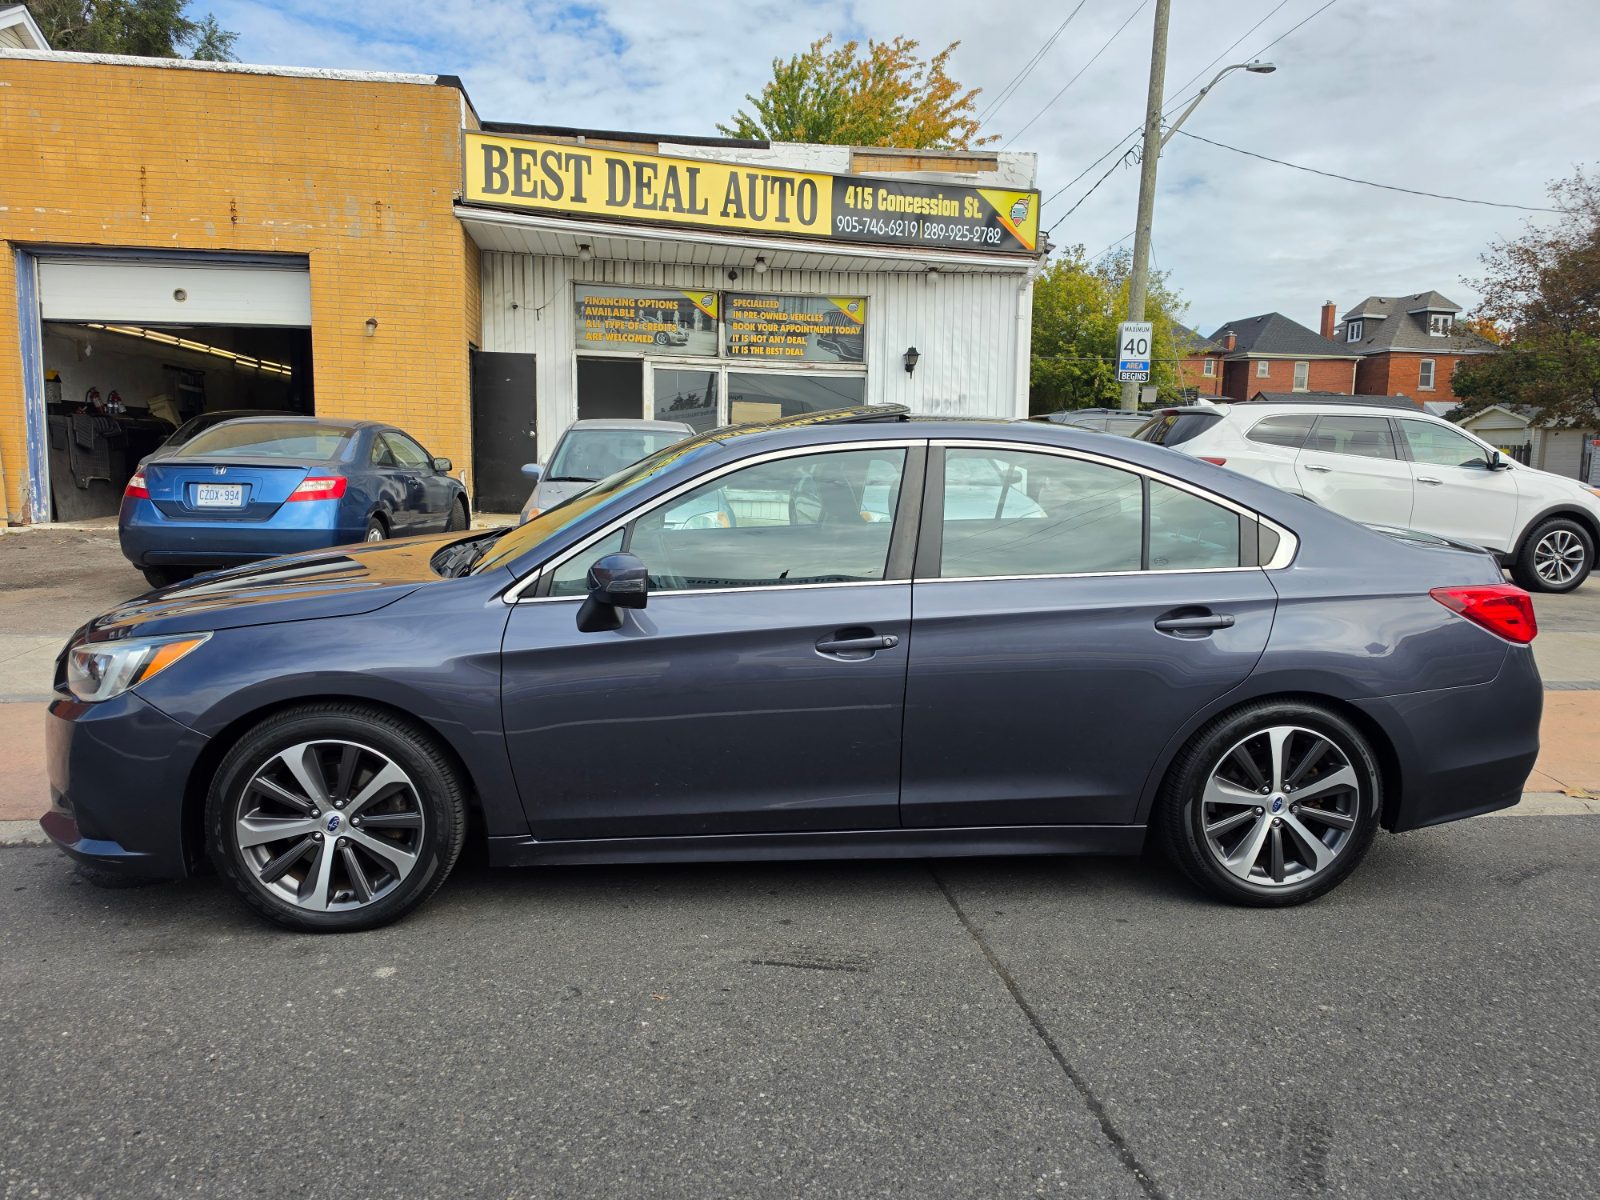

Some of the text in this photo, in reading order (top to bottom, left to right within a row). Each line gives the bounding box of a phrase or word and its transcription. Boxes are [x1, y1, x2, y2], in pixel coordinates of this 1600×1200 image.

[481, 143, 818, 226] BEST DEAL AUTO
[844, 185, 982, 219] 415 Concession St.
[836, 215, 1001, 244] 905-746-6219 289-925-2782
[584, 296, 679, 310] FINANCING OPTIONS
[733, 298, 780, 309] SPECIALIZED
[585, 306, 635, 318] AVAILABLE
[732, 310, 824, 322] IN PRE-OWNED VEHICLES
[585, 319, 677, 333] ALL TYPE OF CREDITS
[732, 322, 861, 335] BOOK YOUR APPOINTMENT TODAY
[585, 332, 654, 344] ARE WELCOMED
[732, 334, 739, 342] IT
[741, 334, 749, 343] IS
[750, 335, 767, 344] NOT
[769, 335, 785, 344] ANY
[732, 345, 804, 356] IT IS THE BEST DEAL
[1123, 338, 1148, 355] 40
[1125, 362, 1144, 370] AREA
[1121, 372, 1147, 381] BEGINS
